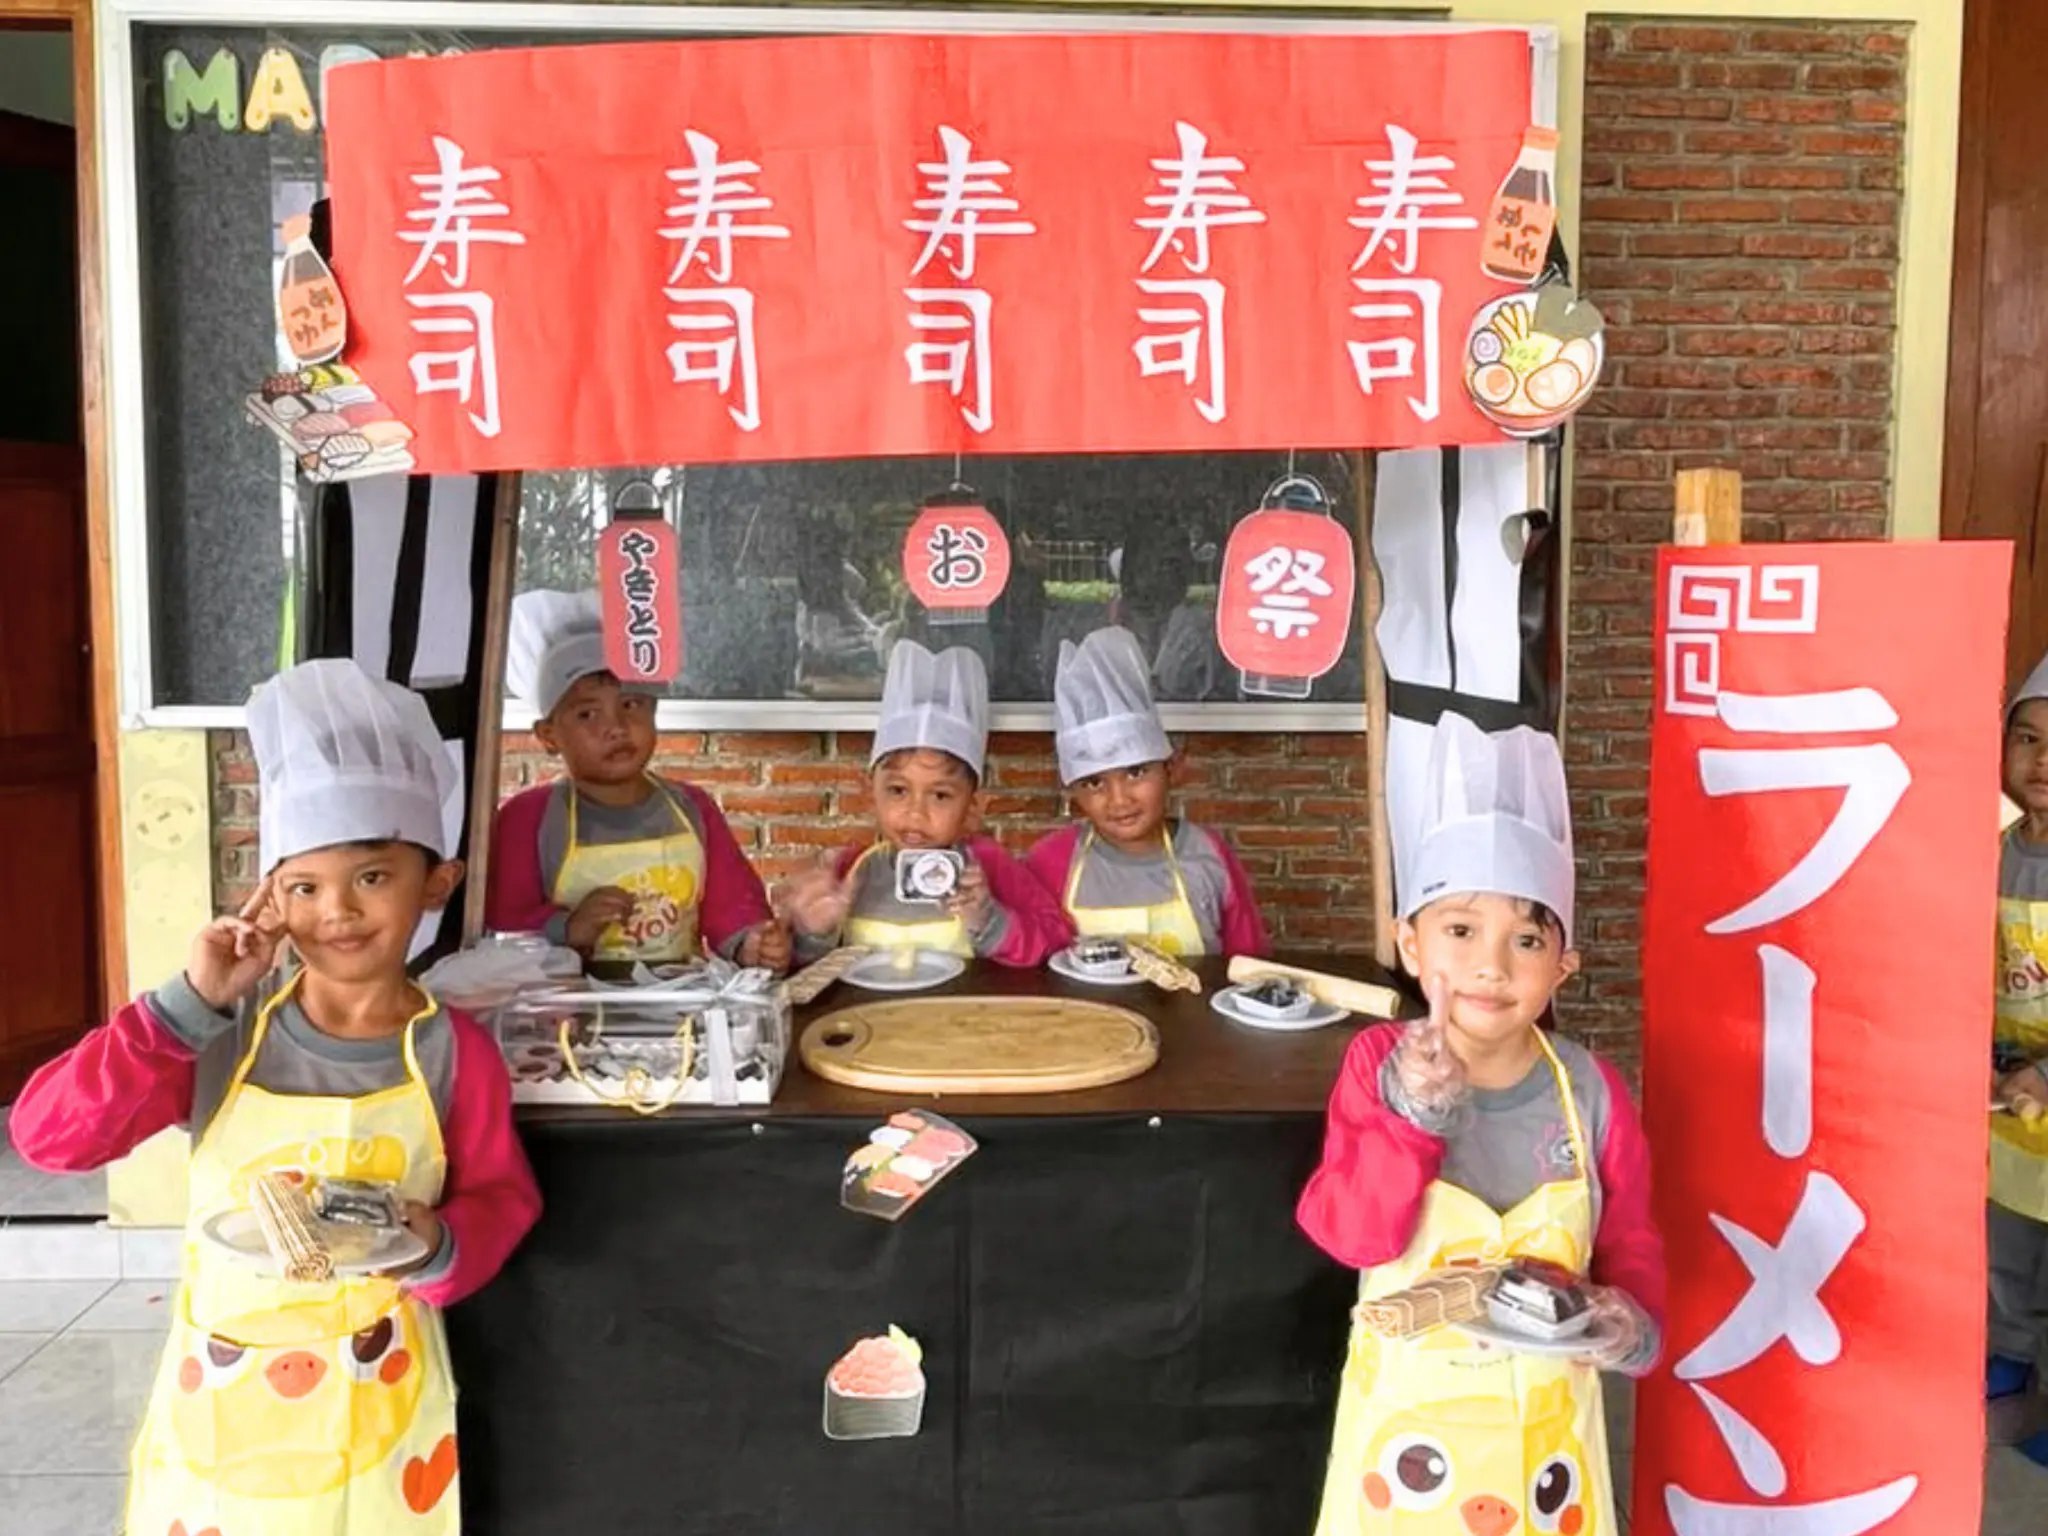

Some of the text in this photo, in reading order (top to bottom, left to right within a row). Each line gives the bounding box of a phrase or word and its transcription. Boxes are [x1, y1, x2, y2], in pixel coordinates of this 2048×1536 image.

[396, 135, 526, 438] 寿司
[659, 130, 791, 431] 寿司
[903, 125, 1037, 433] 寿司
[1133, 121, 1266, 423] 寿司
[1347, 123, 1479, 422] 寿司
[620, 530, 660, 674] やきとり
[928, 525, 987, 588] お
[1243, 545, 1333, 640] 祭
[1664, 686, 1917, 1536] ラーメン
